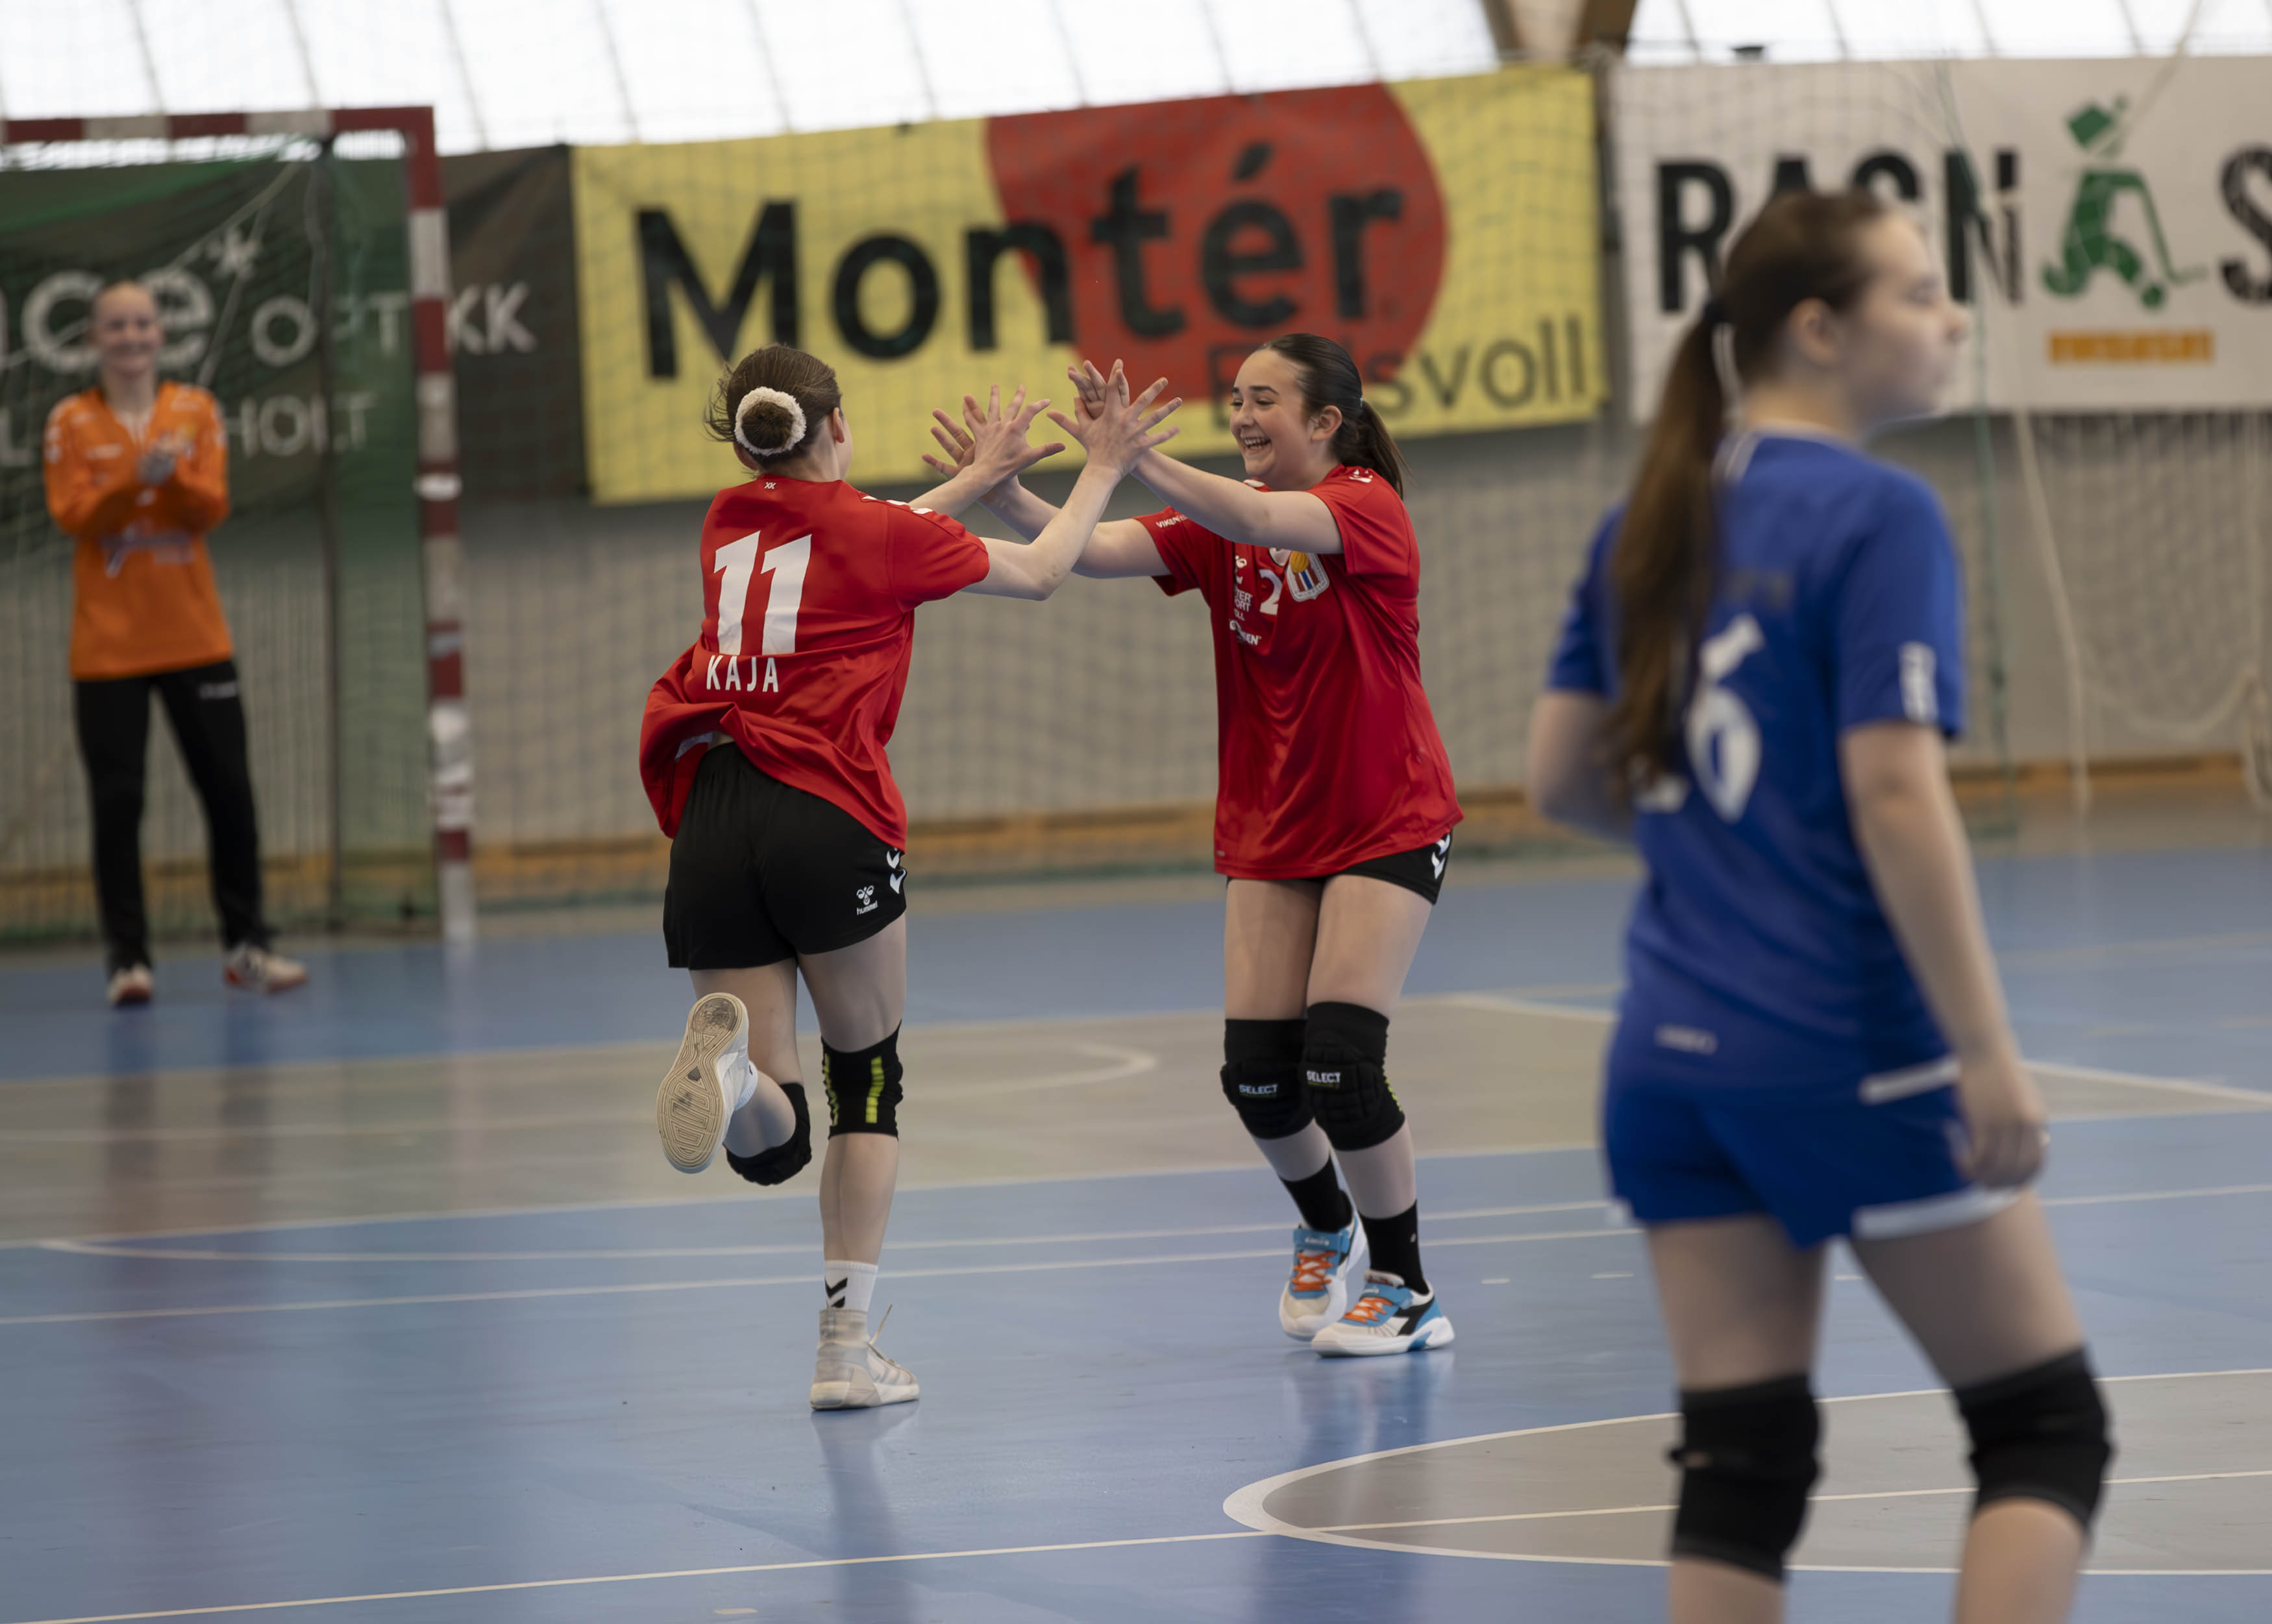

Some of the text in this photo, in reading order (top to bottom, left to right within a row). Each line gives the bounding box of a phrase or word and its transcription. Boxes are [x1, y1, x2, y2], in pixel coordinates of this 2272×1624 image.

[635, 141, 1405, 380] Montér
[713, 530, 812, 656] 11
[706, 654, 779, 693] KAJA
[1238, 1083, 1278, 1095] SELECT
[1306, 1070, 1341, 1083] SELECT
